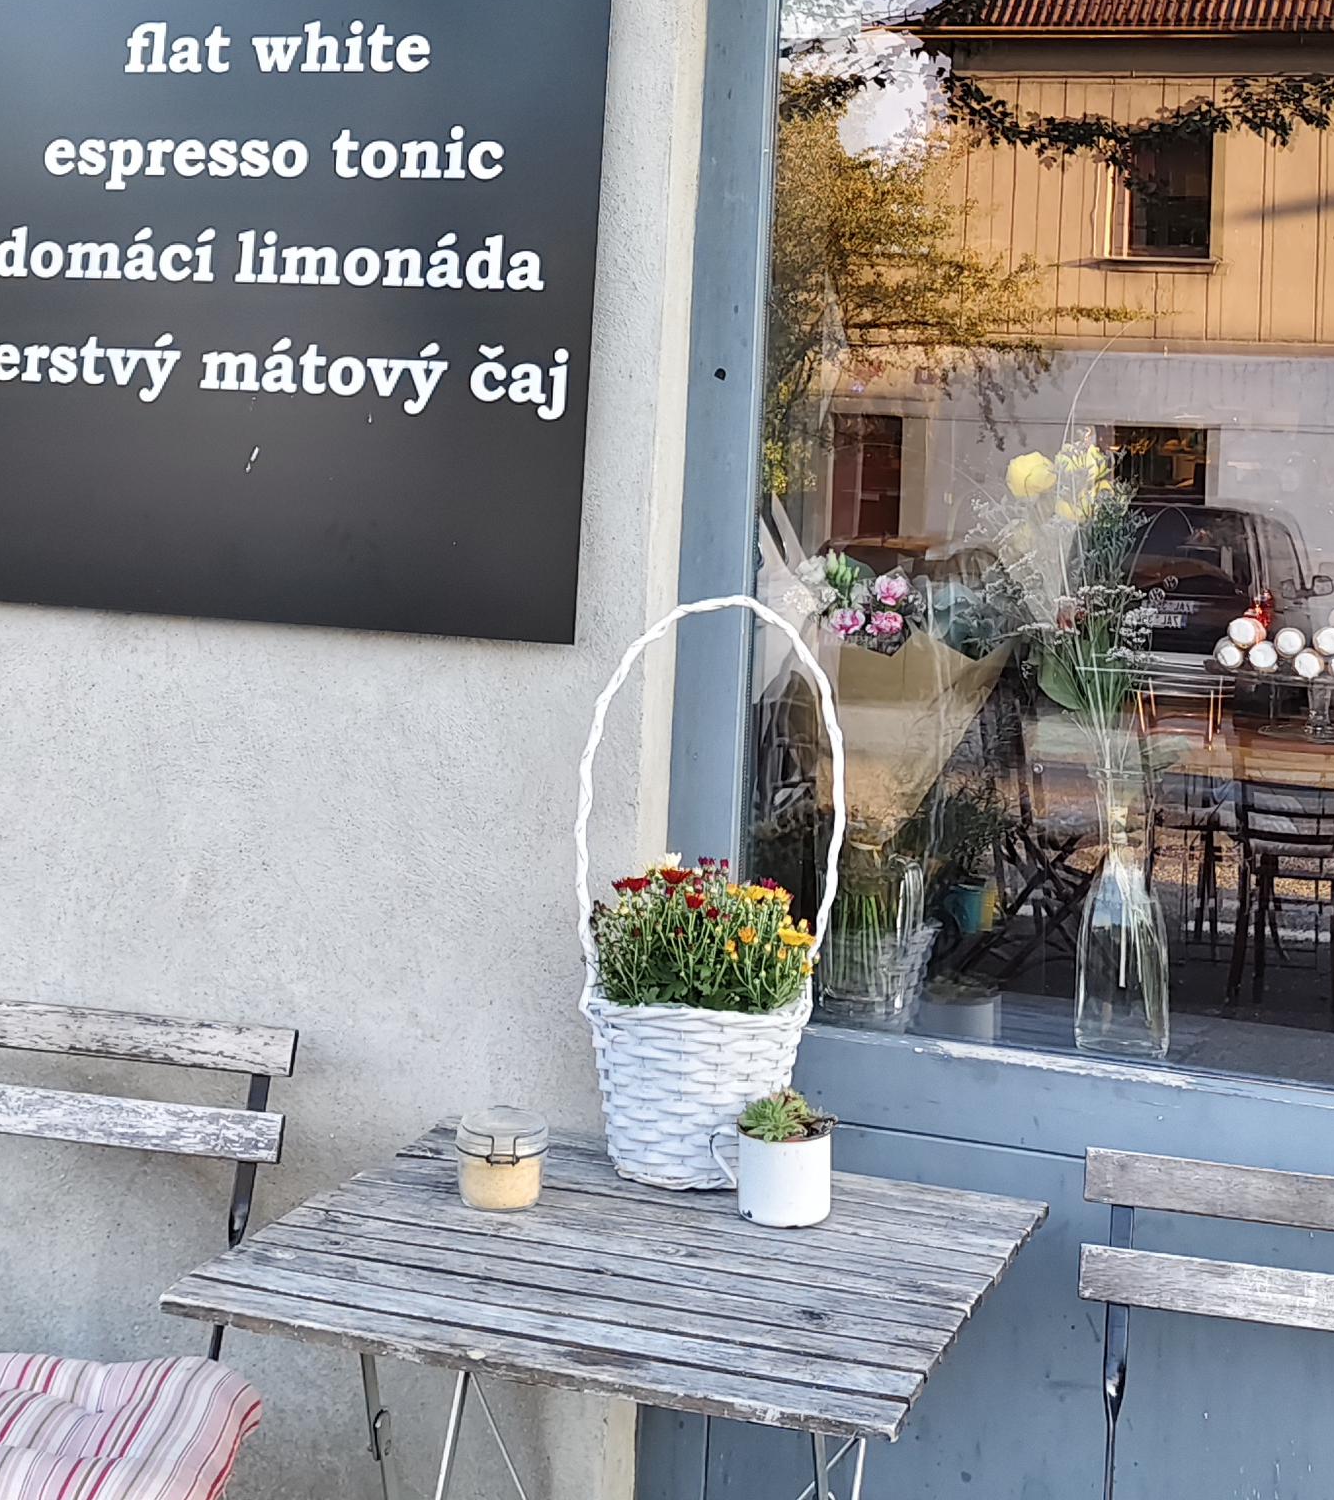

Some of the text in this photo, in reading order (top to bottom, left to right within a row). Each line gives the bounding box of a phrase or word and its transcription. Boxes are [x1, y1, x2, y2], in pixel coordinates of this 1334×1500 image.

[124, 20, 431, 74] flat white
[44, 125, 505, 190] espresso tonic
[234, 229, 545, 291] limonáda
[199, 336, 449, 415] mátový
[470, 344, 569, 420] čaj
